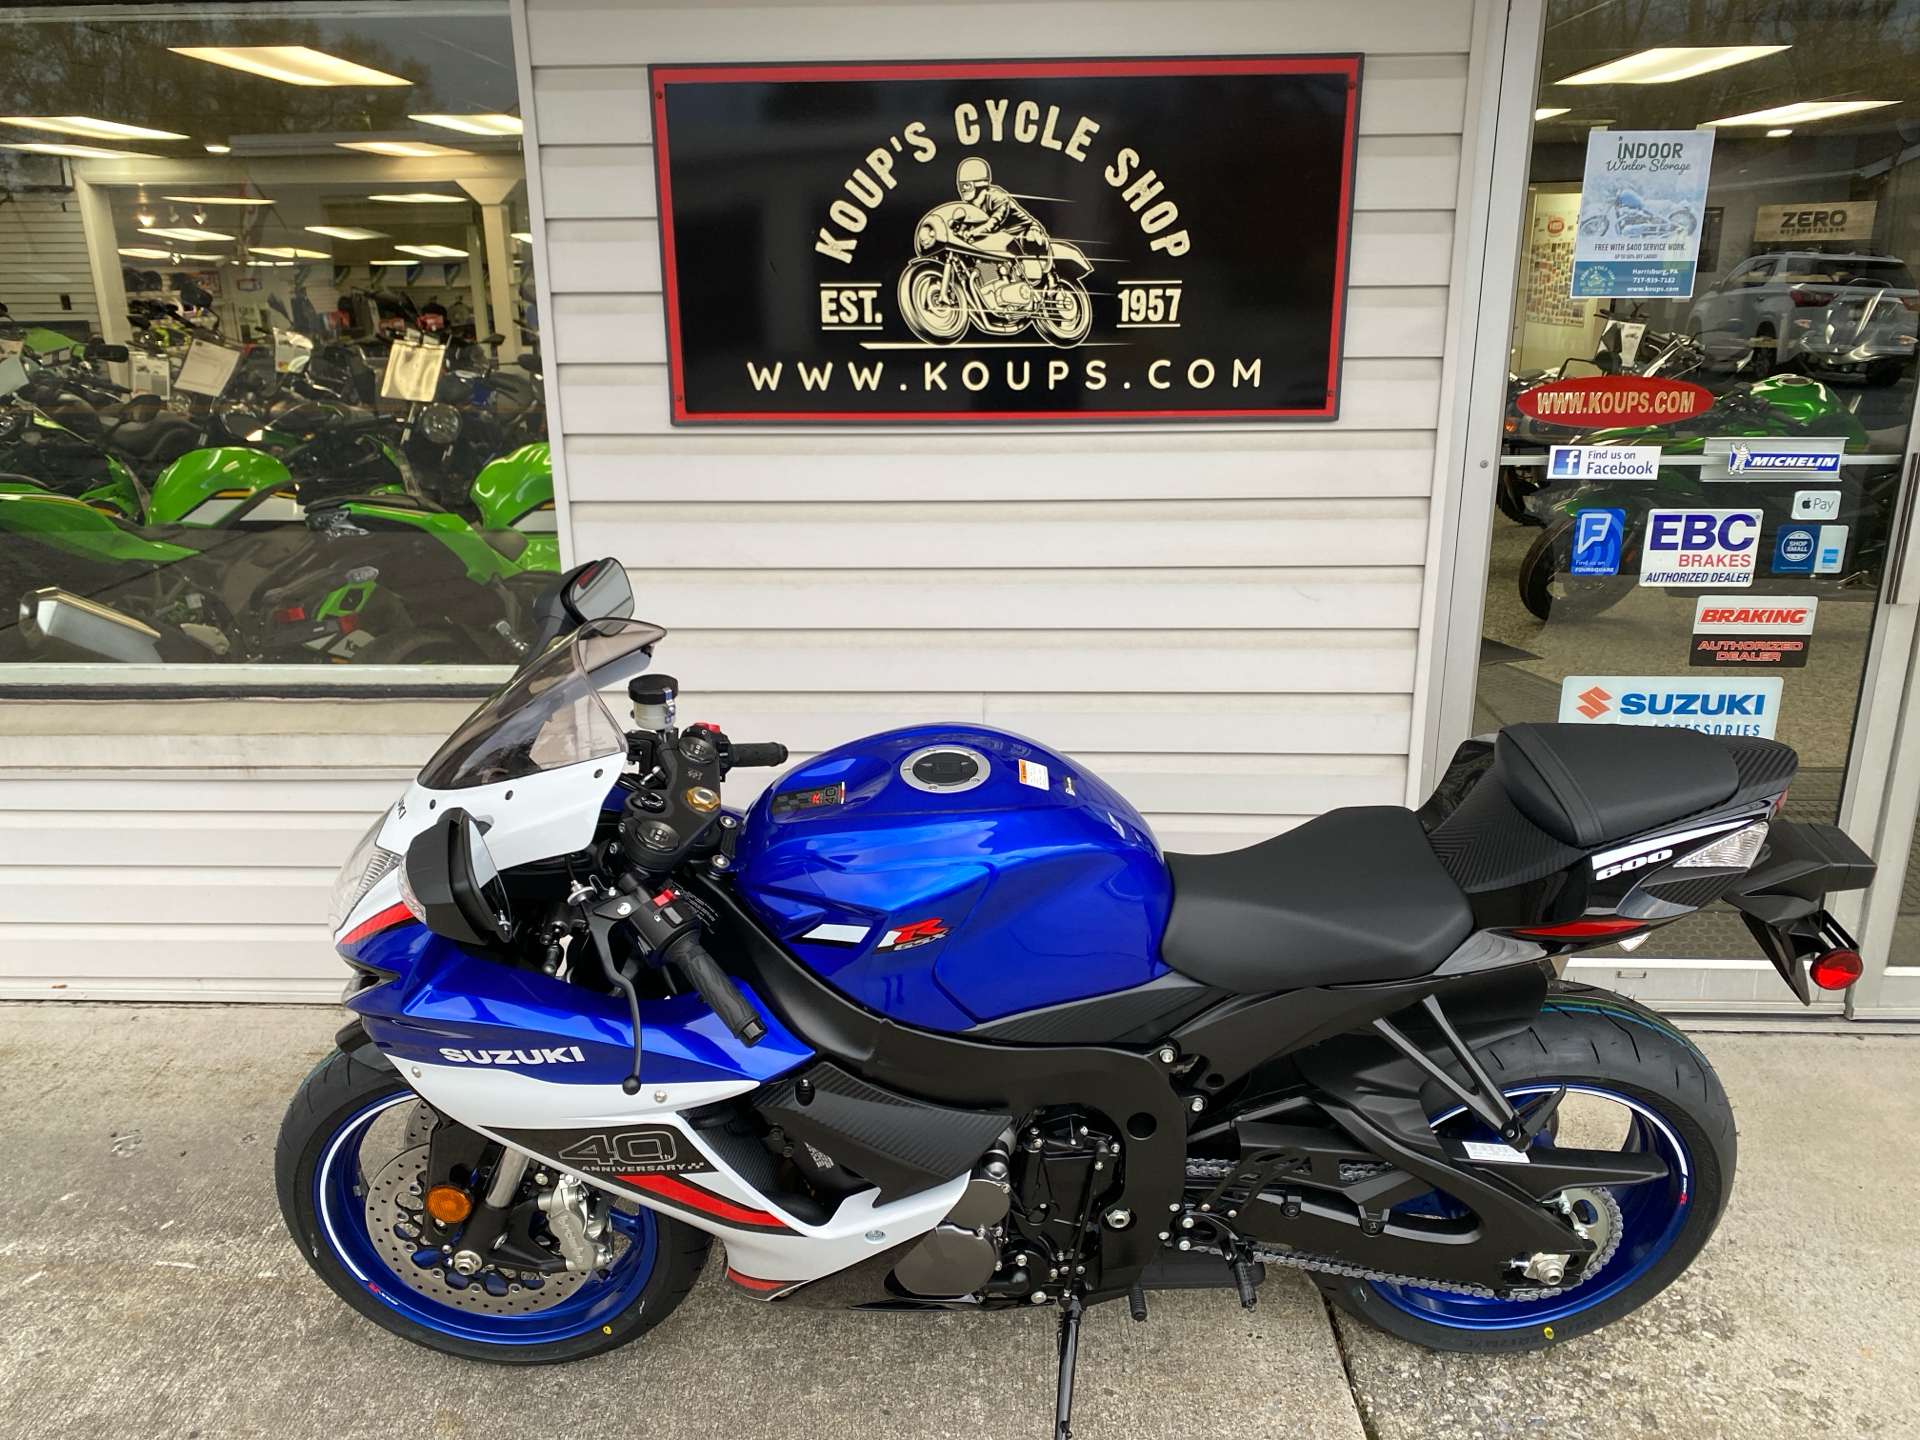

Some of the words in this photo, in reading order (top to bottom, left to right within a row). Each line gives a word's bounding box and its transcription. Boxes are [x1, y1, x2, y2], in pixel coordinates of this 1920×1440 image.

[1617, 137, 1684, 159] INDOOR
[1606, 158, 1647, 172] Winter
[1649, 158, 1691, 176] Storage
[814, 121, 937, 264] KOUP'S
[954, 98, 1101, 163] CYCLE
[1104, 147, 1191, 260] SHOP
[1781, 210, 1848, 228] ZERO
[1594, 243, 1609, 251] FREE
[1610, 243, 1625, 251] WITH
[1626, 243, 1641, 251] $400
[1643, 243, 1666, 251] SERVICE
[1632, 268, 1669, 276] Harrisburg,
[821, 290, 882, 323] EST.
[1117, 288, 1182, 323] 1957
[747, 358, 1262, 391] WWW.KOUPS.COM
[1537, 391, 1696, 415] WWW.KOUPS.COM
[1588, 450, 1607, 459] Find
[1611, 452, 1621, 460] us
[1624, 452, 1635, 460] on
[1751, 456, 1837, 467] MICHELIN
[1586, 461, 1653, 475] Facebook
[1813, 498, 1835, 512] Pay
[1649, 514, 1757, 551] EBC
[1678, 554, 1751, 567] BRAKES
[1645, 572, 1708, 583] AUTHORIZED
[1710, 572, 1750, 583] DEALER
[1700, 608, 1808, 624] BRAKING
[1697, 640, 1804, 651] AUTHORIZED
[1716, 651, 1782, 662] DEALER
[1620, 693, 1766, 715] SUZUKI
[1595, 849, 1673, 881] 600
[438, 1046, 585, 1065] SUZUKI
[581, 1164, 686, 1172] ANNIVERSARY
